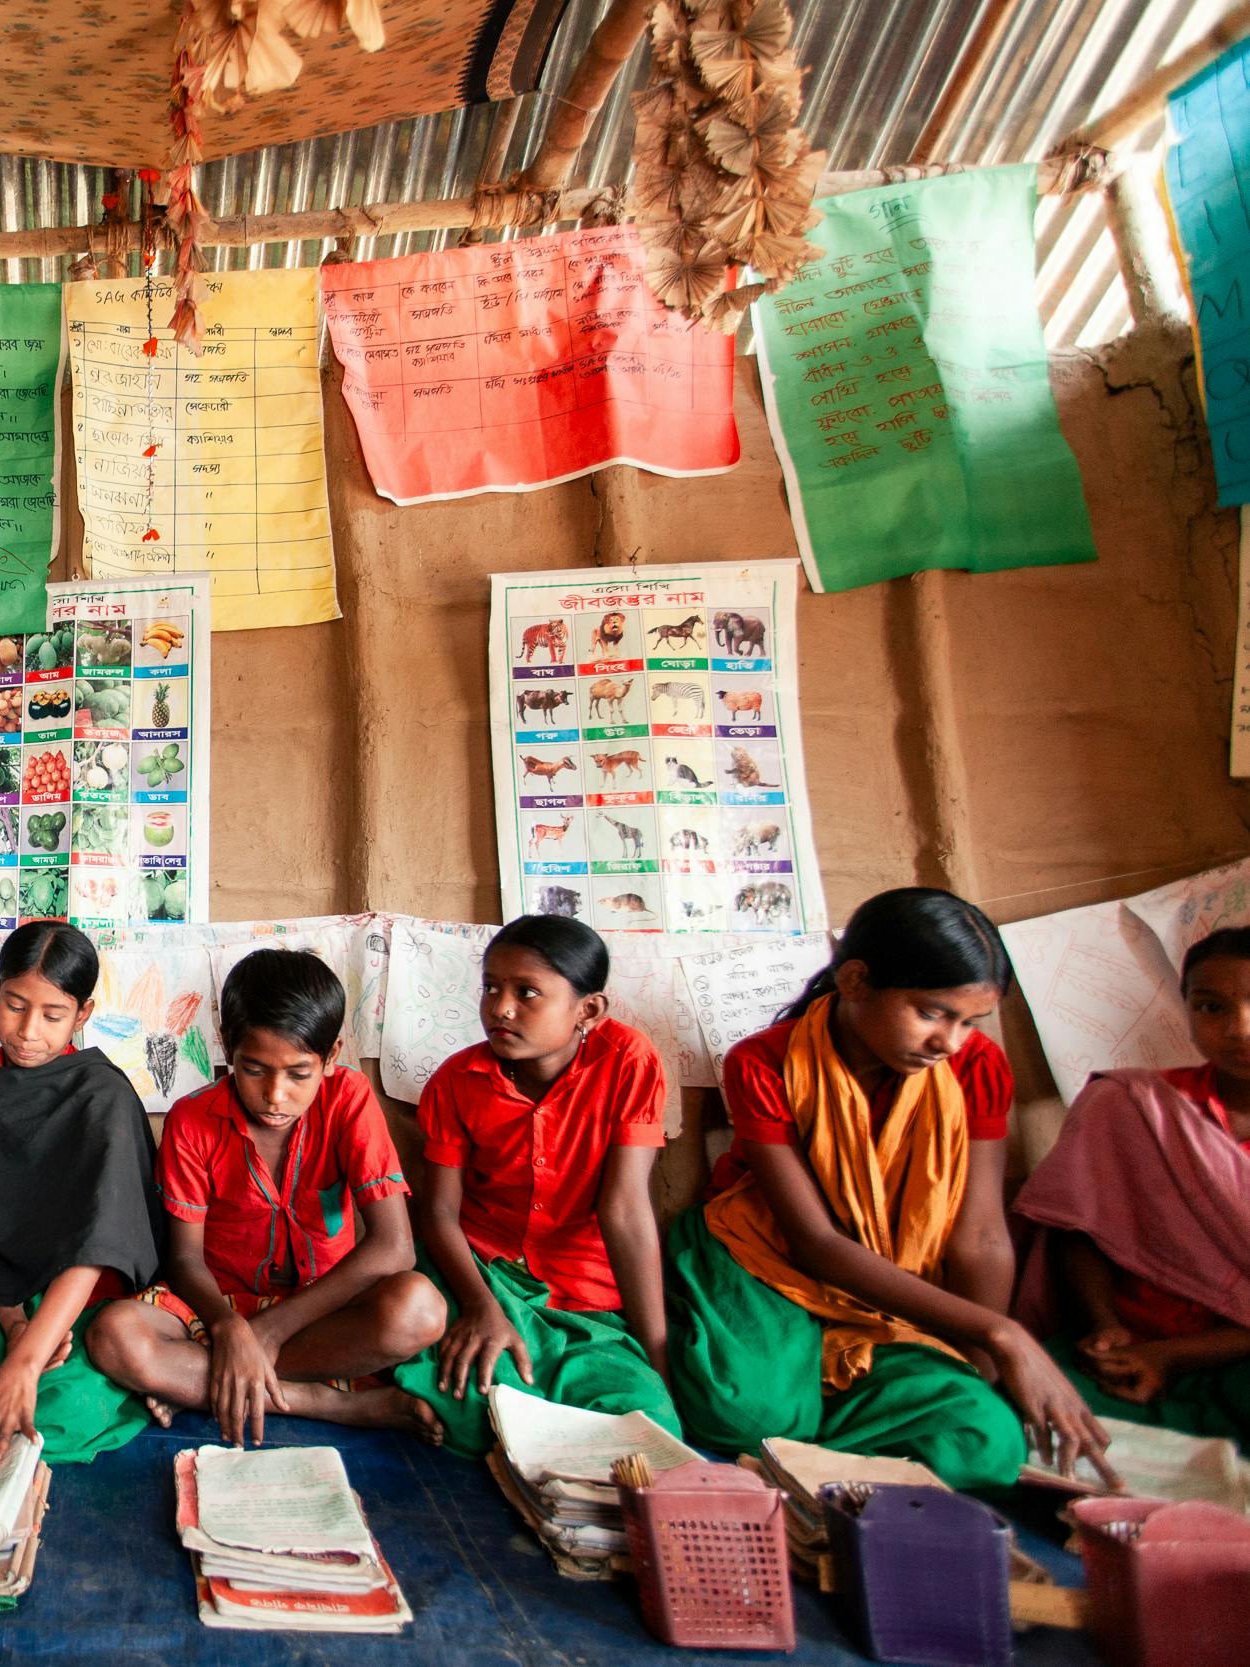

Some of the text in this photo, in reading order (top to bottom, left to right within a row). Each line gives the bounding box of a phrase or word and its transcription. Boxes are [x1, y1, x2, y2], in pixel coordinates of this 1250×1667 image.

[95, 290, 130, 304] SAG
[23, 338, 46, 352] জয়
[14, 383, 50, 402] জেনেছি
[23, 491, 61, 513] জেনেছি
[592, 580, 671, 594] এসো শিখি
[559, 590, 706, 612] জীবজন্তুর নাম
[87, 603, 126, 616] নাম
[595, 663, 626, 673] সিংহ
[661, 657, 696, 669] ঘোড়া
[725, 659, 754, 670] হাতি
[40, 670, 60, 680] আম
[82, 667, 124, 677] জামরুল
[150, 667, 172, 676] কলা
[531, 666, 554, 677] বাঘ
[38, 729, 57, 740] তাল
[139, 728, 181, 738] আনারস
[535, 730, 559, 740] গরু
[729, 725, 761, 737] ভেড়া
[33, 792, 62, 802] ডালিম
[148, 792, 169, 802] ডাব
[535, 797, 567, 808] ছাগল
[33, 855, 58, 865] আমড়া
